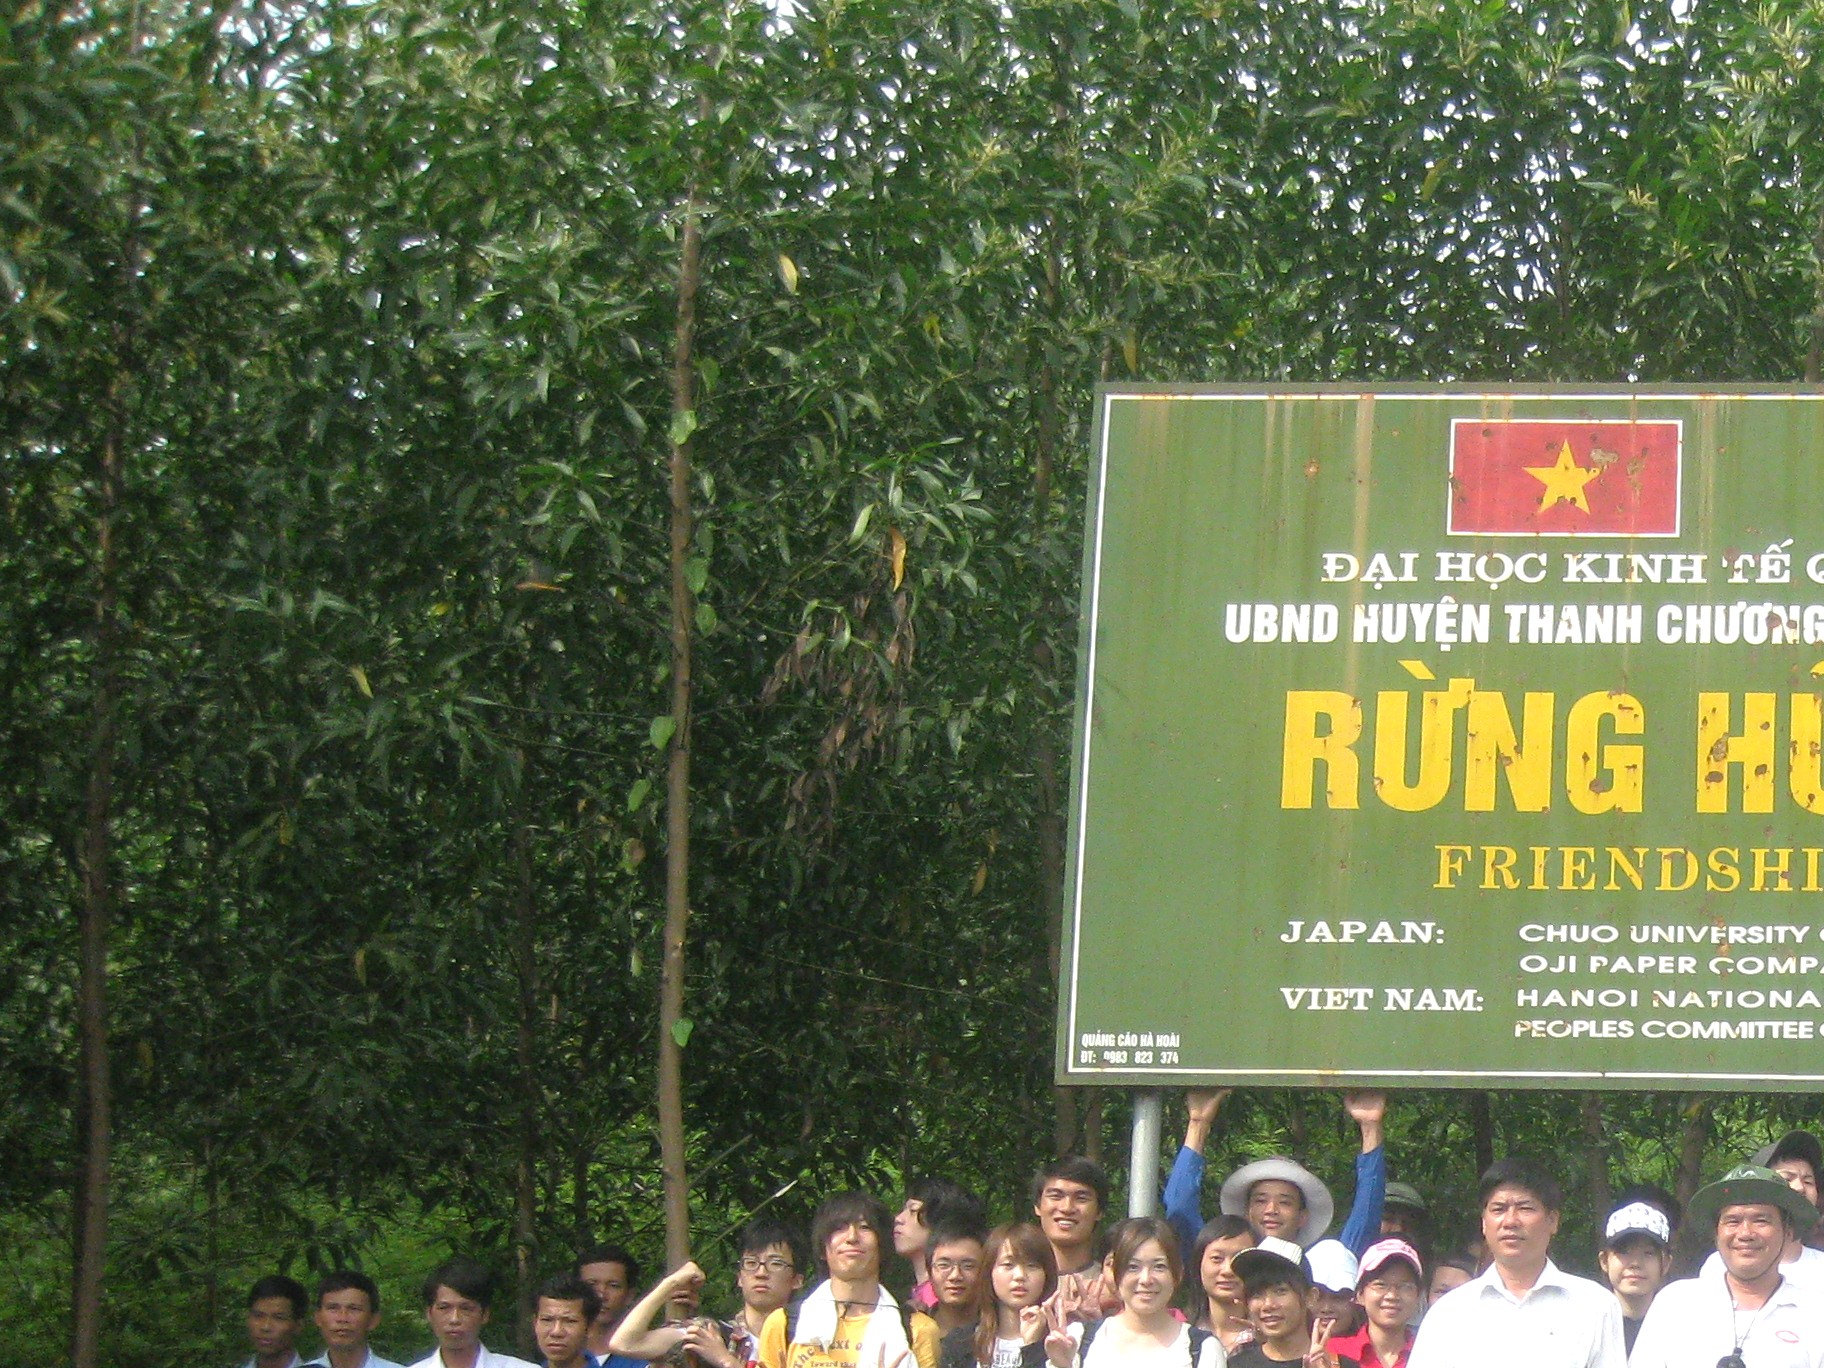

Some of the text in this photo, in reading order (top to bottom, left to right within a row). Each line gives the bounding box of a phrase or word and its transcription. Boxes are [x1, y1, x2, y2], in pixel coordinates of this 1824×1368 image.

[1321, 552, 1419, 590] ĐẠI
[1434, 551, 1548, 590] HỌC
[1562, 552, 1708, 584] KINH
[1721, 538, 1794, 584] TẾ
[1224, 603, 1339, 643] UBND
[1352, 595, 1491, 652] HUYỆN
[1504, 604, 1643, 644] THANH
[1280, 659, 1645, 815] RỪNG
[1280, 920, 1444, 944] JAPAN:
[1519, 924, 1619, 943] CHUO
[1630, 925, 1811, 944] UNIVERSITY
[1519, 954, 1577, 973] OJI
[1589, 955, 1697, 974] PAPER
[1279, 987, 1484, 1012] VIET NAM:
[1517, 988, 1638, 1008] HANOI
[1139, 1031, 1154, 1048] HÀ
[1514, 1019, 1635, 1038] PEOPLES
[1641, 1020, 1814, 1040] COMMITTEE
